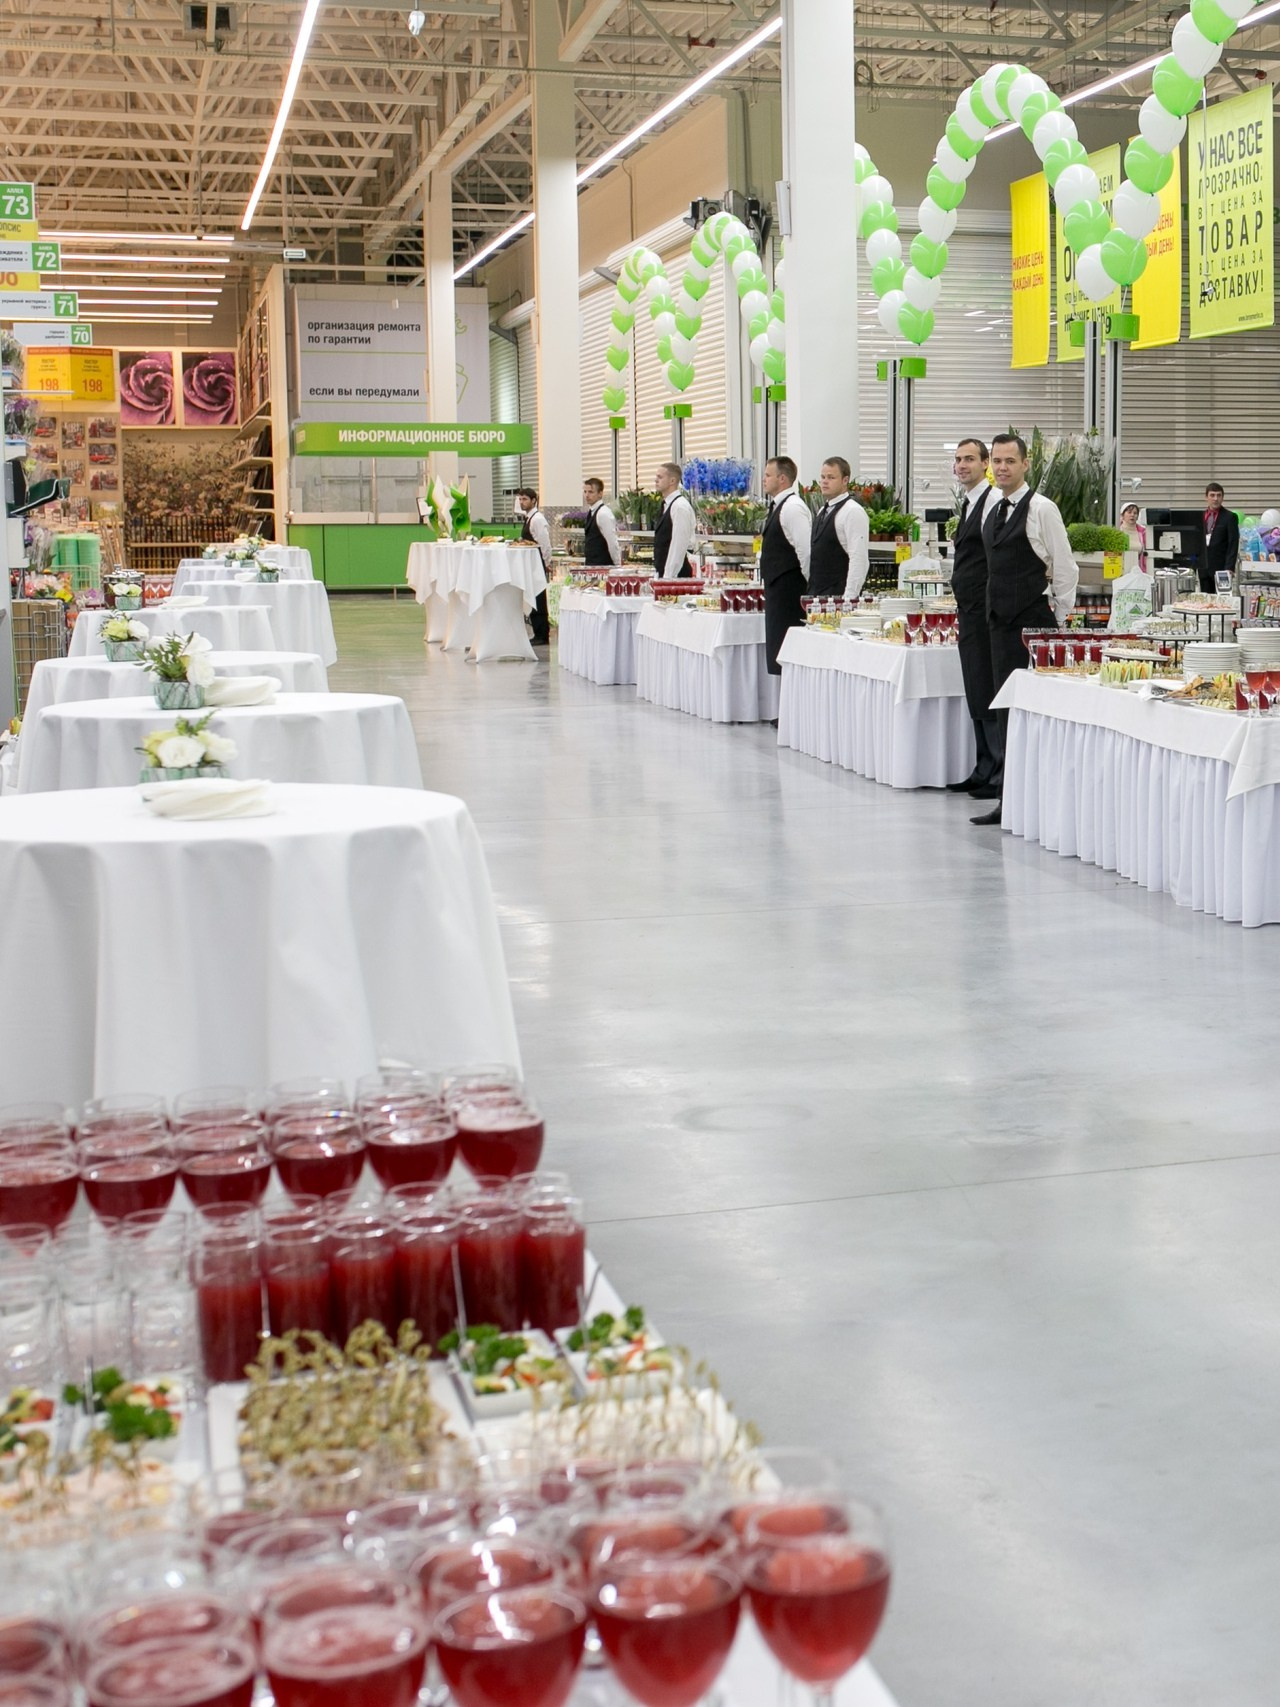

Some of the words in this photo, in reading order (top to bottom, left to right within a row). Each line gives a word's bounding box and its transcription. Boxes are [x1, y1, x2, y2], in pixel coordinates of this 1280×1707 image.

[1197, 141, 1205, 171] У
[1209, 130, 1235, 169] НАС
[1238, 120, 1263, 160] ВСЕ
[1198, 161, 1263, 199] ПРОЗРАЧНО:
[2, 195, 30, 216] 73
[1198, 201, 1215, 221] ВТ
[1220, 195, 1246, 215] ЦЕНА
[1252, 190, 1264, 206] ЗА
[1198, 210, 1264, 256] ТОВАР
[34, 251, 57, 268] 72
[1221, 252, 1246, 272] ЦЕНА
[1252, 249, 1264, 264] ЗА
[57, 300, 75, 314] 71
[307, 321, 375, 332] организация
[377, 321, 421, 332] ремонта
[73, 331, 89, 343] 70
[307, 336, 320, 344] по
[323, 336, 371, 345] гарантии
[39, 378, 60, 391] 198
[82, 378, 103, 392] 198
[309, 387, 335, 396] если
[337, 387, 352, 396] вы
[355, 387, 420, 398] передумали
[338, 430, 465, 445] ИНФОРМАЦИОННОЕ
[468, 430, 506, 443] БЮРО
